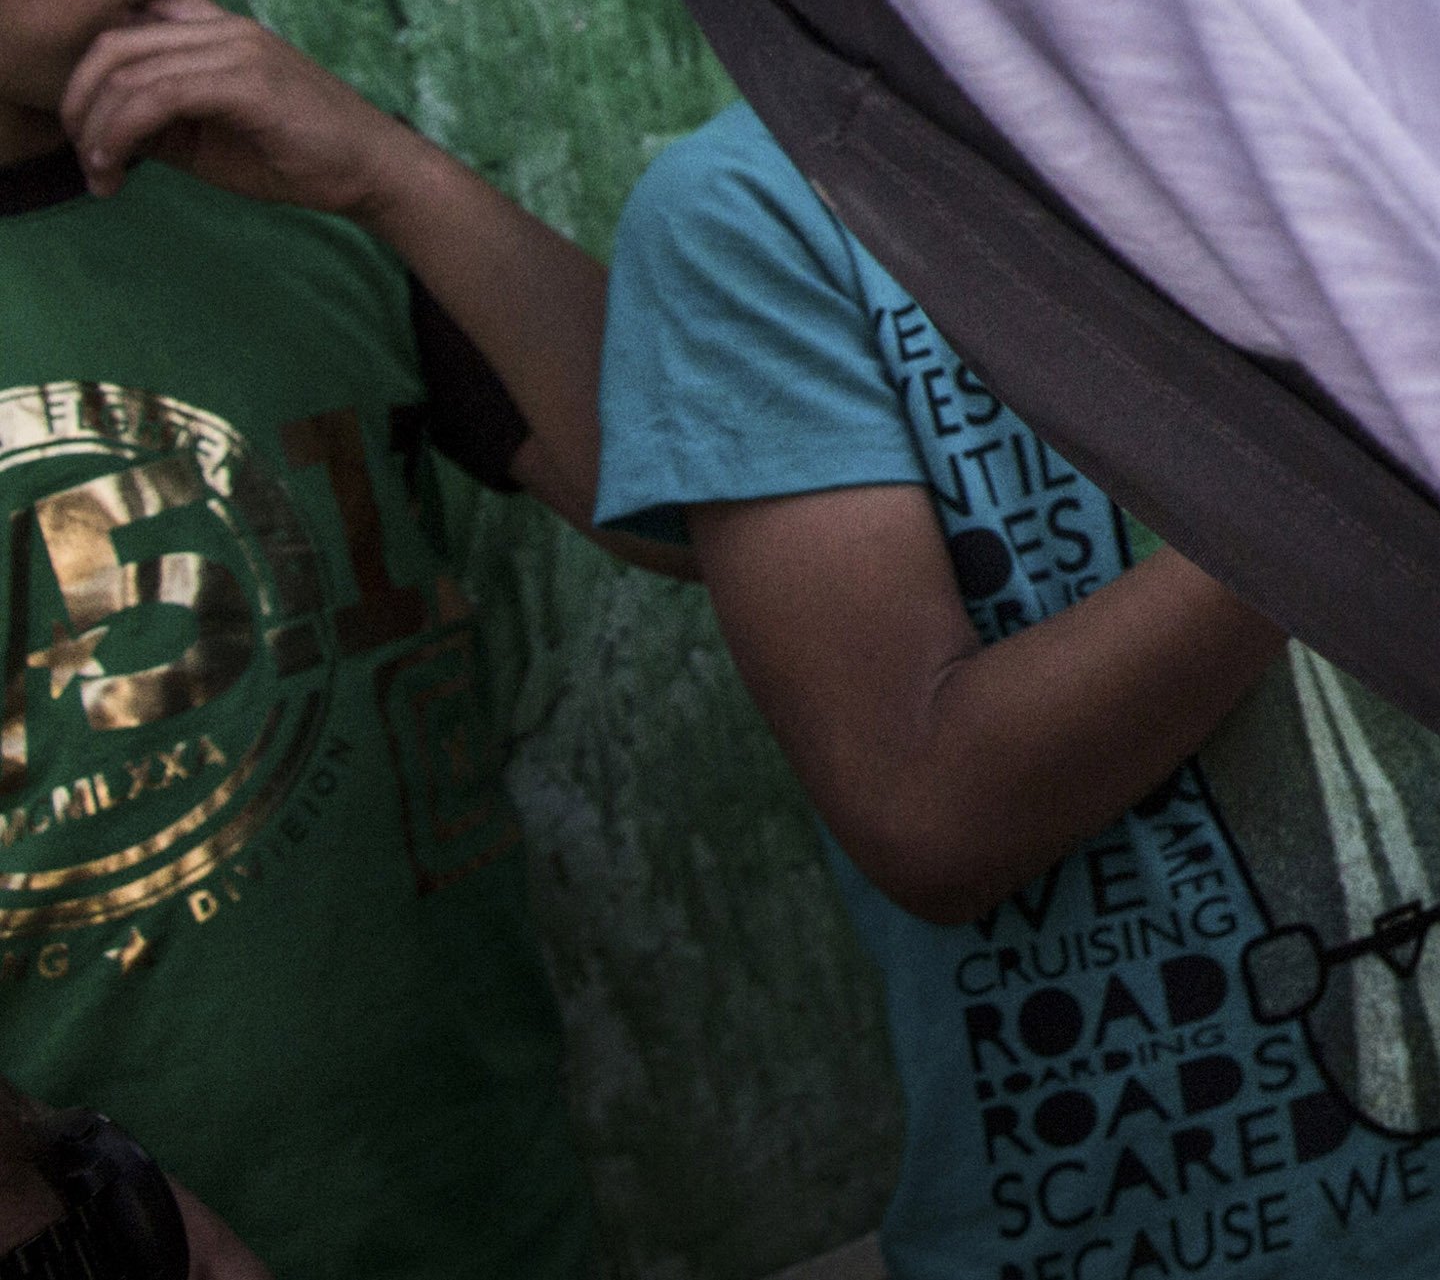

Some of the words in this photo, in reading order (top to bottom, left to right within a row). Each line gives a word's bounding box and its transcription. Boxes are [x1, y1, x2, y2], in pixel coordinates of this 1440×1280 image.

[955, 895, 1237, 997] CRUISING
[964, 952, 1228, 1075] ROAD
[982, 1037, 1298, 1166] ROADS
[990, 1089, 1352, 1240] SCARED
